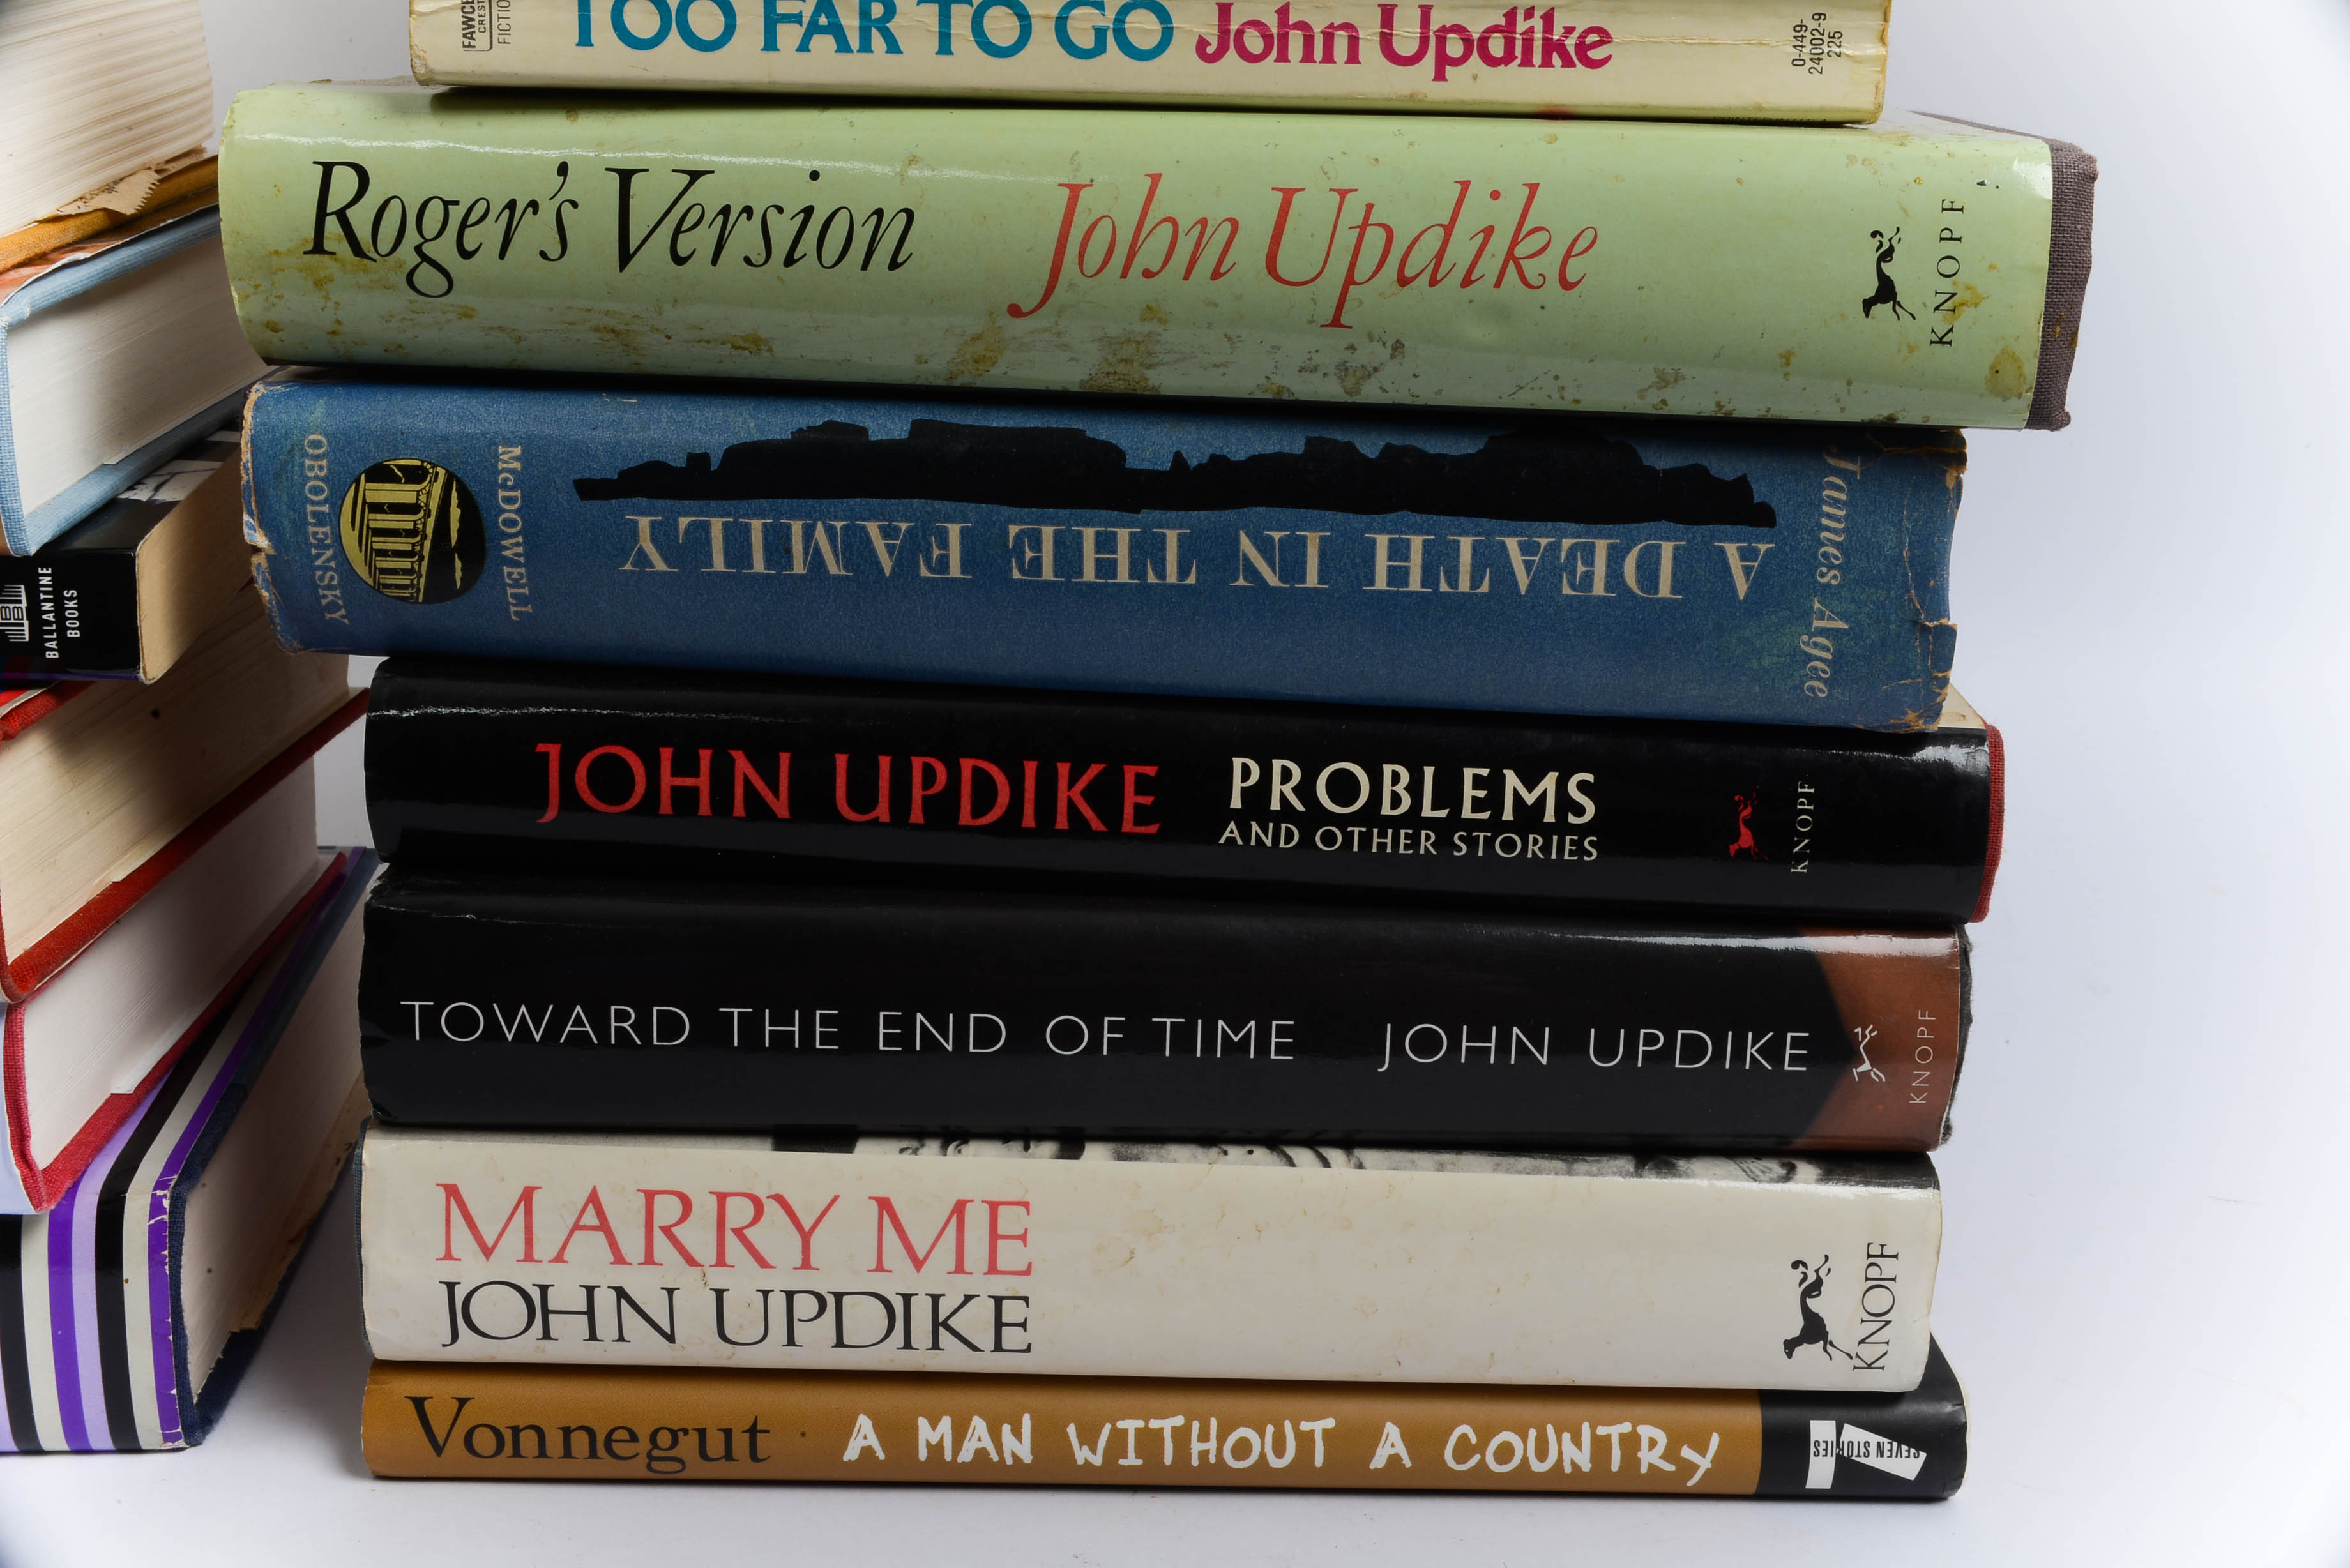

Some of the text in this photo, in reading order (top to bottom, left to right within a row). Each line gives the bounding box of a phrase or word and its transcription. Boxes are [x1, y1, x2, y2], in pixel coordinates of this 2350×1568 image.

[760, 0, 904, 54] FAR
[917, 0, 1033, 59] TO
[1054, 0, 1174, 62] GO
[1195, 2, 1362, 64] John
[1377, 4, 1614, 82] Updike
[1791, 19, 1808, 67] 0-449-
[1808, 12, 1827, 75] 24002-9
[1827, 31, 1843, 57] 225
[303, 161, 1599, 330] Roger's Version John Updike
[1929, 199, 1964, 347] KNOPF
[304, 433, 349, 624] OBOLENSKY
[498, 445, 533, 621] McDOWELL
[618, 515, 1775, 601] A DEATH IN THE FAMILY
[1800, 445, 1862, 698] James Agee
[38, 567, 59, 658] BALLANTINE
[63, 589, 80, 637] BOOKS
[534, 743, 1161, 834] JOHN UPDIKE
[1229, 757, 1596, 824] PROBLEMS
[1791, 781, 1815, 873] KNOPF
[1218, 820, 1598, 861] AND OTHER STORIES
[400, 1001, 1810, 1072] TOWARD THE END OF TIME JOHN UPDIKE
[1909, 1009, 1936, 1104] KNOPF
[436, 1183, 1033, 1276] MARRY ME
[441, 1280, 1033, 1354] JOHN UPDIKE
[1853, 1242, 1899, 1371] KNOPF
[404, 1396, 1720, 1486] Vonnegut A MAN WITHOUT A COUNTRY
[1814, 1440, 1920, 1459] SEVEN STORIES
